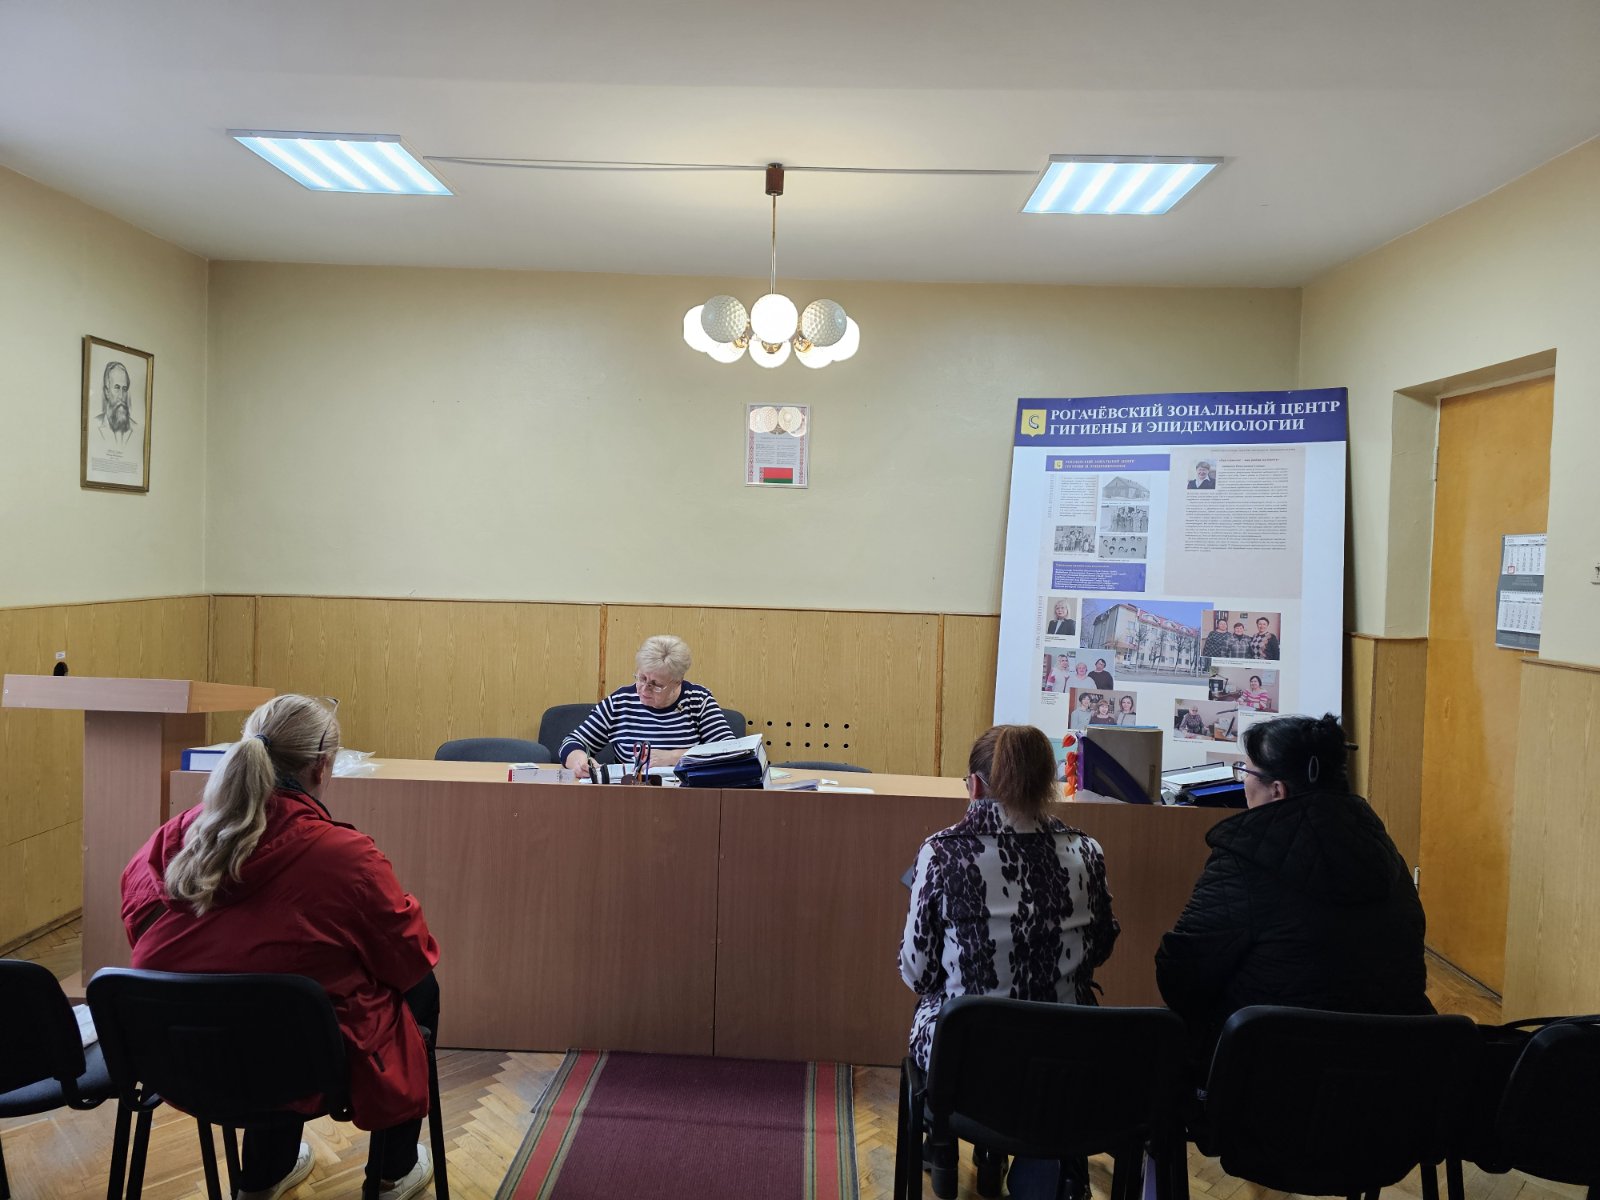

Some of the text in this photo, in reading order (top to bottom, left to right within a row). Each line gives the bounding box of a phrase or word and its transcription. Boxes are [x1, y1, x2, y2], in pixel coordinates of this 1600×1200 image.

[1051, 400, 1340, 420] РОГАЧЁВСКИЙ ЗОНАЛЬНЫЙ ЦЕНТР
[1050, 418, 1305, 435] ГИГИЕНЫ И ЭПИДЕМИОЛОГИИ
